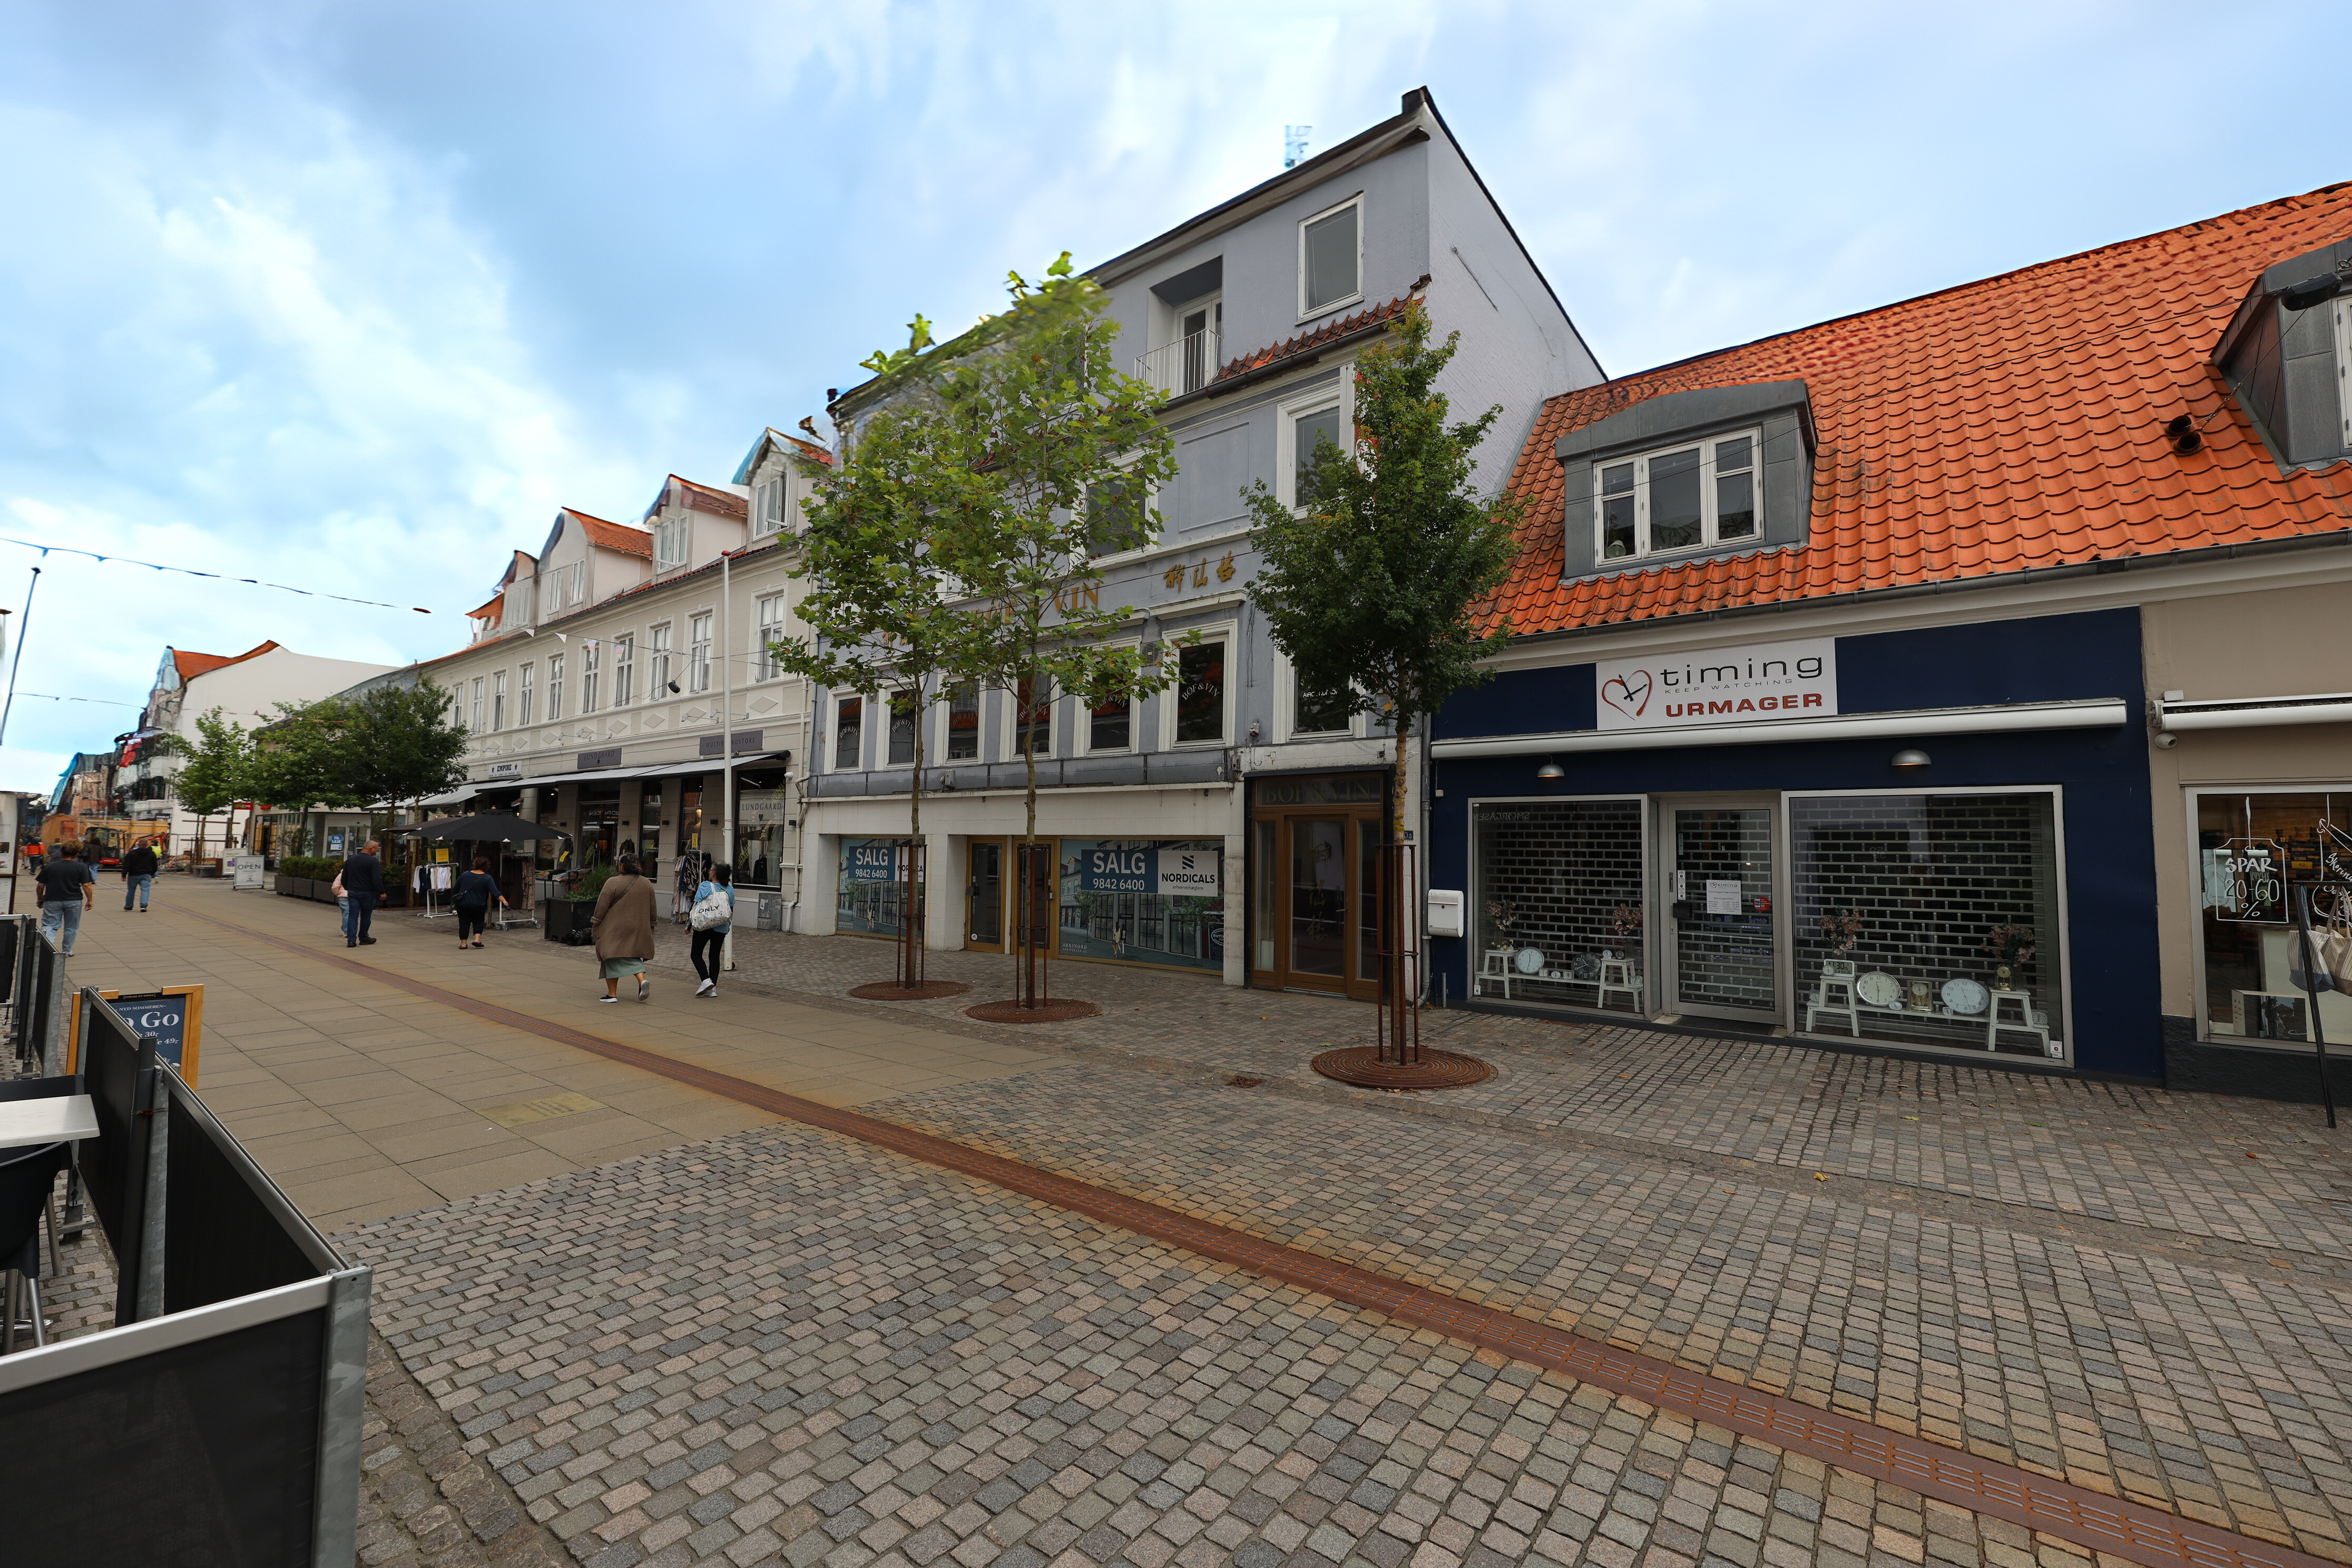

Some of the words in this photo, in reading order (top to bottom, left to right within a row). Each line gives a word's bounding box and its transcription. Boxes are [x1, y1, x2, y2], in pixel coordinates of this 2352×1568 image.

[1052, 582, 1100, 613] VIN
[1660, 656, 1822, 686] timing
[1711, 679, 1792, 690] WATCHING
[1666, 693, 1822, 718] URMAGER
[706, 737, 755, 747] MULTIBNDSTORE
[584, 750, 614, 760] LUNDGAARD
[1328, 780, 1371, 800] VIN
[856, 848, 888, 866] SALG
[1093, 852, 1145, 874] SALG
[2225, 857, 2278, 873] SPAR
[856, 869, 870, 878] 9842
[871, 869, 887, 878] 6400
[1162, 873, 1215, 884] NORDICALS
[1093, 878, 1116, 889] 9842
[1120, 879, 1145, 890] 6400
[2224, 878, 2280, 902] 20-60
[699, 905, 720, 914] ONLY
[2241, 901, 2260, 918] %
[141, 1012, 179, 1027] Go
